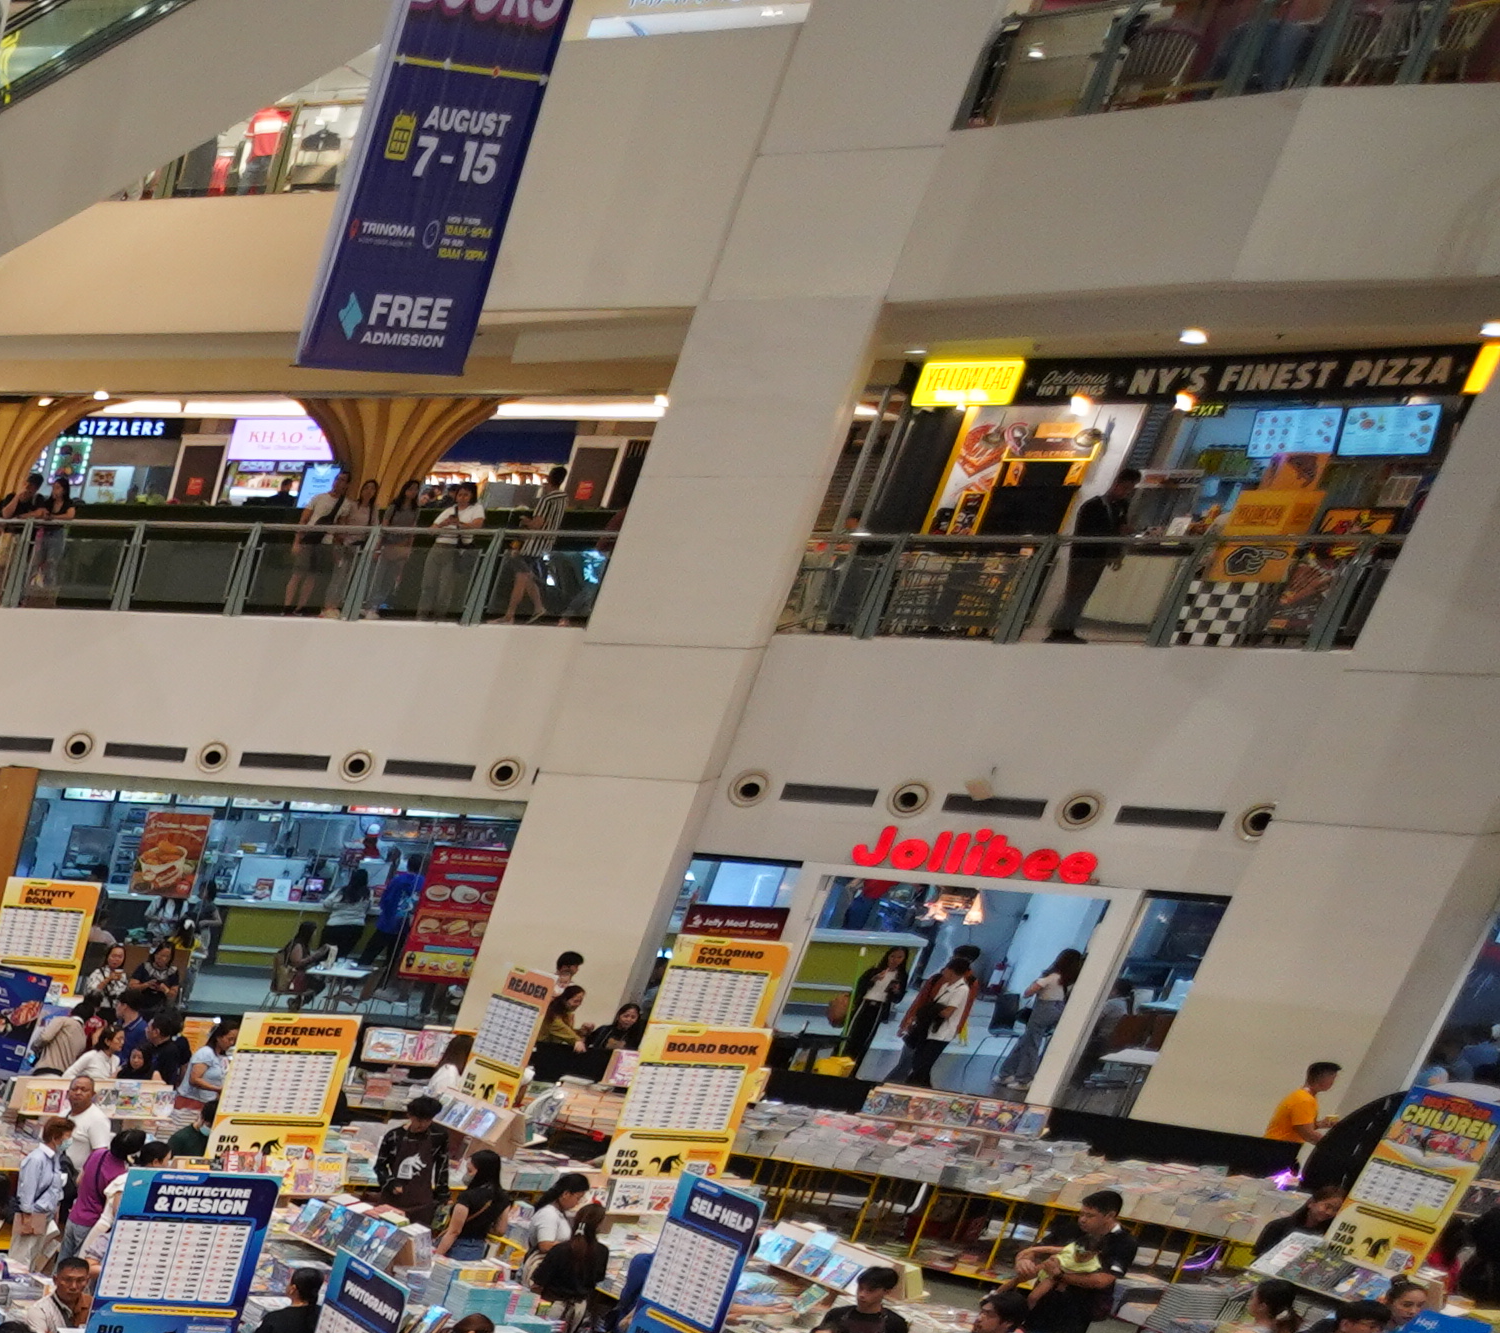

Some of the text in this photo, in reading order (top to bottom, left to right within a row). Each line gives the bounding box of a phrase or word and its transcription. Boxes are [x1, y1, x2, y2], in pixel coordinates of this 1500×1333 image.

[423, 106, 511, 136] AUGUST
[361, 222, 415, 238] TRINOMA
[367, 294, 452, 330] FREE
[361, 332, 444, 348] ADMISSION
[926, 364, 1014, 391] YELLOW CAB
[1041, 370, 1109, 387] Delicious
[1126, 358, 1451, 395] NY'S FINEST PIZZA
[1037, 383, 1107, 396] HOT WINGS
[78, 420, 165, 436] SIZZLERS
[852, 825, 1098, 885] Jollibee
[25, 896, 53, 905] BOOK
[26, 888, 75, 899] ACTIVITY
[697, 956, 732, 967] BOOK
[698, 947, 764, 960] COLORING
[508, 977, 548, 1000] READER
[267, 1025, 343, 1038] REFERENCE
[264, 1036, 299, 1048] BOOK
[666, 1042, 759, 1058] BOARD BOOK
[1402, 1105, 1496, 1140] CHILDREN
[617, 1149, 638, 1160] BIG
[614, 1159, 639, 1169] BAD
[157, 1184, 252, 1200] ARCHITECTURE
[155, 1196, 248, 1216] & DESIGN
[690, 1198, 754, 1234] SELF HELP
[343, 1279, 400, 1323] PHOTOGRAPHY
